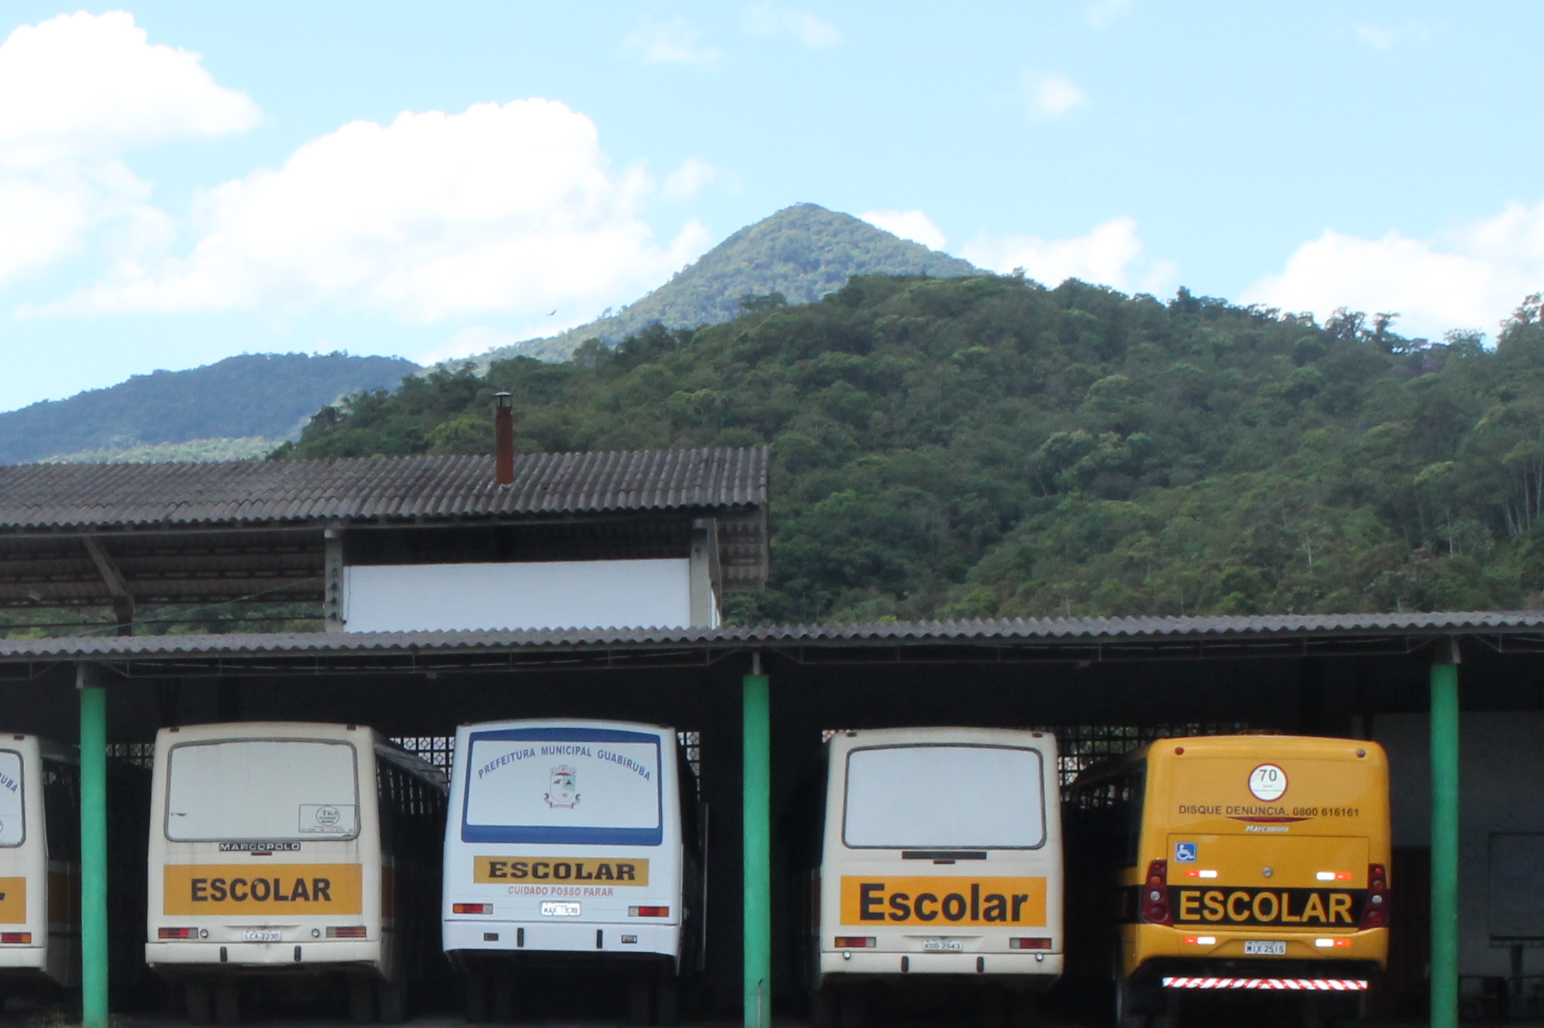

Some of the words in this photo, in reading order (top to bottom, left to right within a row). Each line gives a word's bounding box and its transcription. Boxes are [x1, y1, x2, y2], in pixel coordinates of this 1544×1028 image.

[478, 748, 536, 779] PREFEITURA
[541, 746, 592, 758] MUNICIPAL
[597, 750, 651, 781] GUABIRUBA
[1259, 769, 1277, 782] 70
[1178, 805, 1222, 815] DISQUE
[1292, 807, 1318, 816] 0800
[1321, 808, 1359, 817] 616161
[220, 843, 300, 851] MARCOPOLO
[488, 861, 635, 881] ESCOLAR
[191, 878, 332, 902] ESCOLAR
[508, 886, 548, 896] CUIDADO
[551, 887, 581, 896] POSSO
[583, 887, 614, 897] PARAR
[859, 883, 1029, 922] Escolar
[1179, 890, 1353, 923] ESCOLAR
